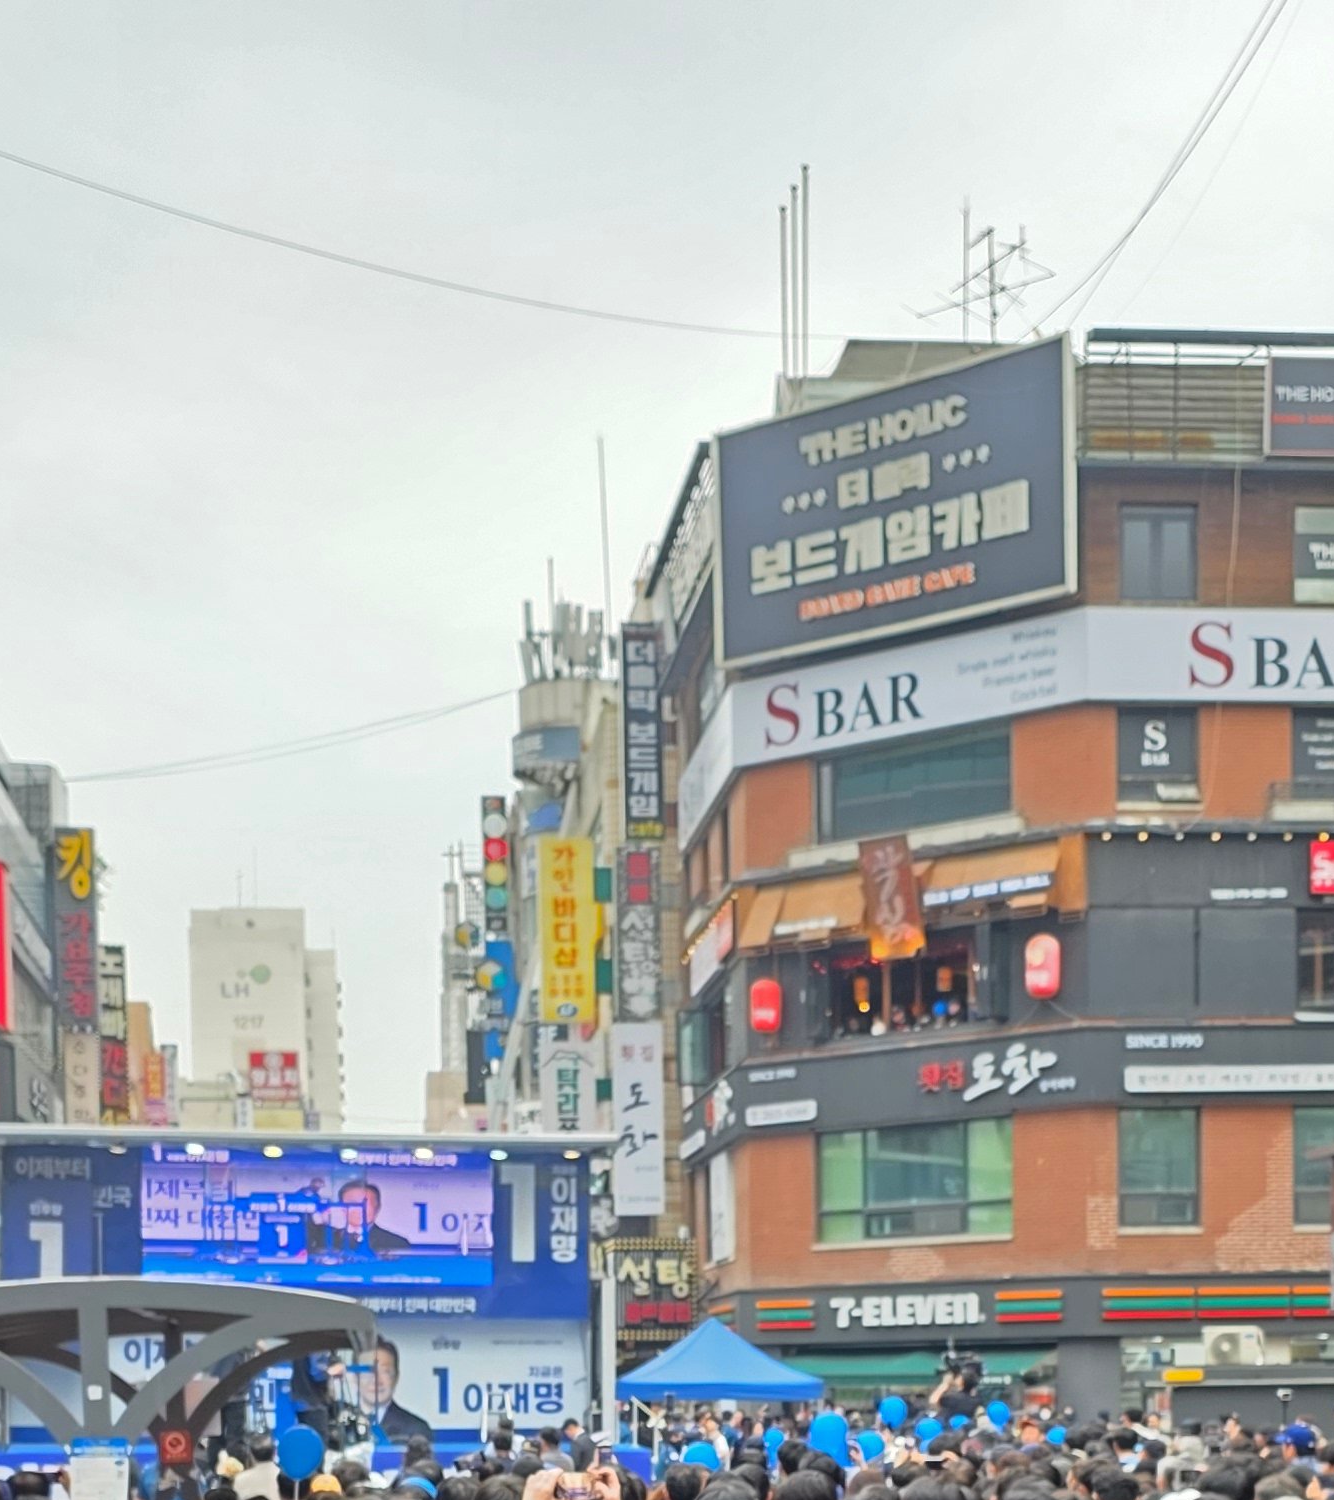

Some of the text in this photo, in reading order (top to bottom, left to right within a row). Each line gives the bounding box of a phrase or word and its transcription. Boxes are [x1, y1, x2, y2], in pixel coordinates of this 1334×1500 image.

[1275, 384, 1309, 404] THE
[799, 394, 968, 466] THE HOLIC
[750, 479, 1030, 596] 보드게임카페
[1188, 619, 1236, 690] S
[763, 671, 924, 750] S BAR
[1143, 719, 1168, 751] S
[56, 829, 93, 899] 킹
[221, 980, 251, 999] LH
[1125, 1033, 1204, 1049] SINCE 1990
[963, 1042, 1057, 1101] 도화
[14, 1155, 92, 1179] 이제부터
[500, 1163, 536, 1263] 1
[550, 1174, 579, 1264] 이재명
[29, 1220, 64, 1278] 1
[829, 1292, 980, 1328] 7-ELEVEN
[432, 1366, 564, 1414] 1 이재명
